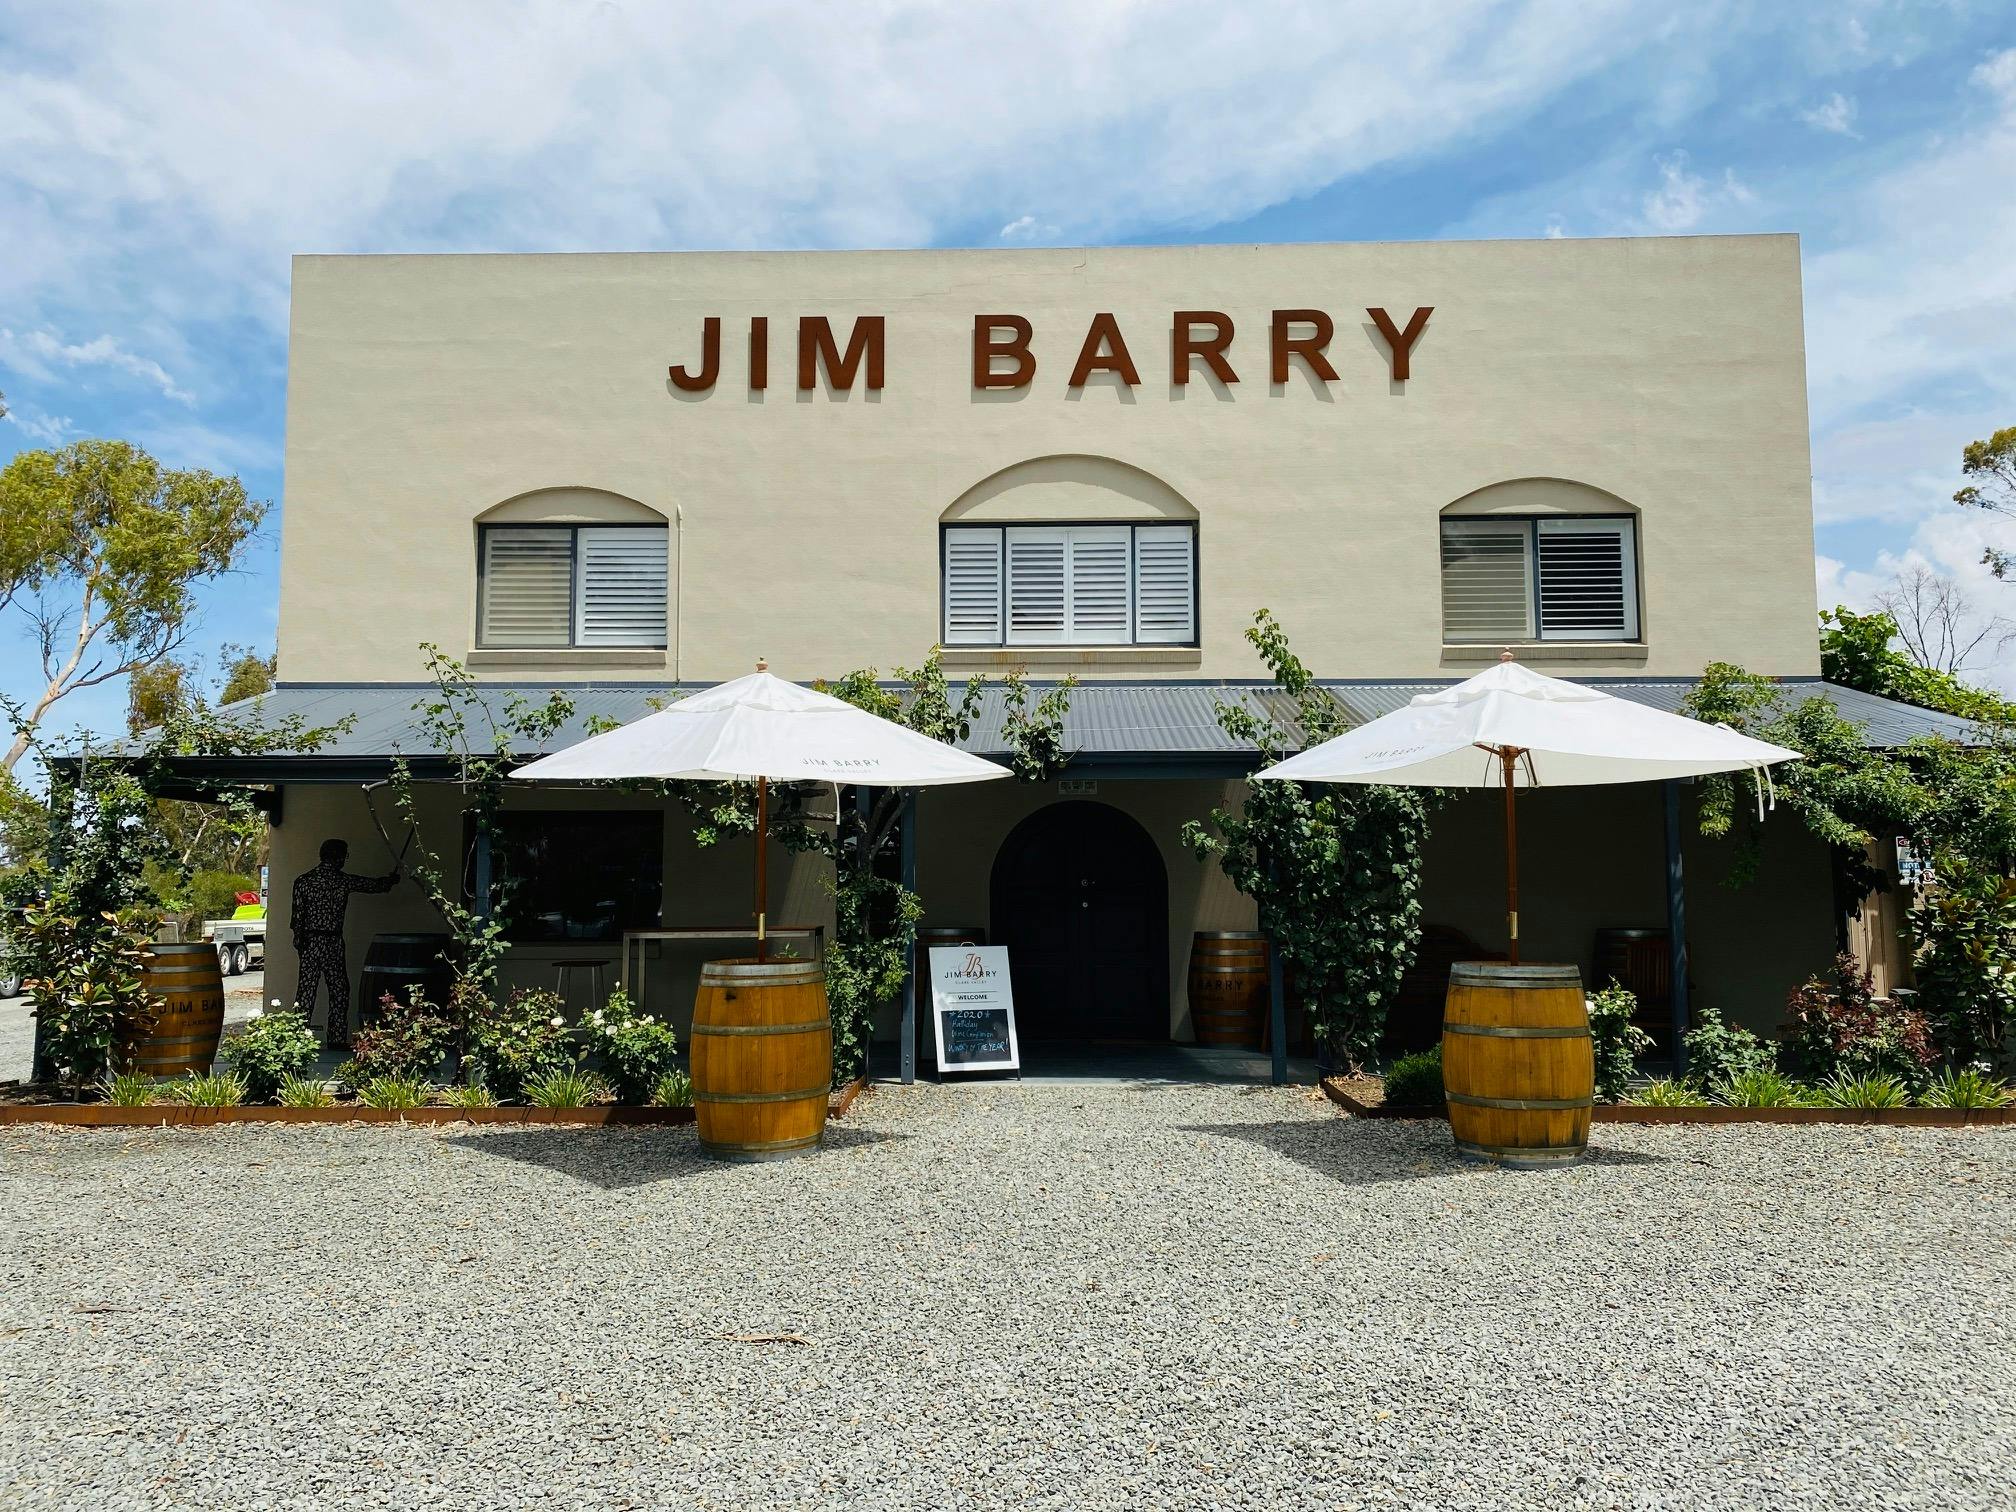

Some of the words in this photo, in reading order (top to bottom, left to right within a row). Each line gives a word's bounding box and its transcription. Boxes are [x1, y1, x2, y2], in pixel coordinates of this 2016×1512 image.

[668, 316, 885, 392] JIM
[974, 307, 1435, 388] BARRY
[802, 758, 829, 767] JIM
[833, 759, 880, 767] BARRY
[944, 971, 962, 979] JIM
[966, 970, 997, 979] BARRY
[158, 1001, 193, 1014] JIM
